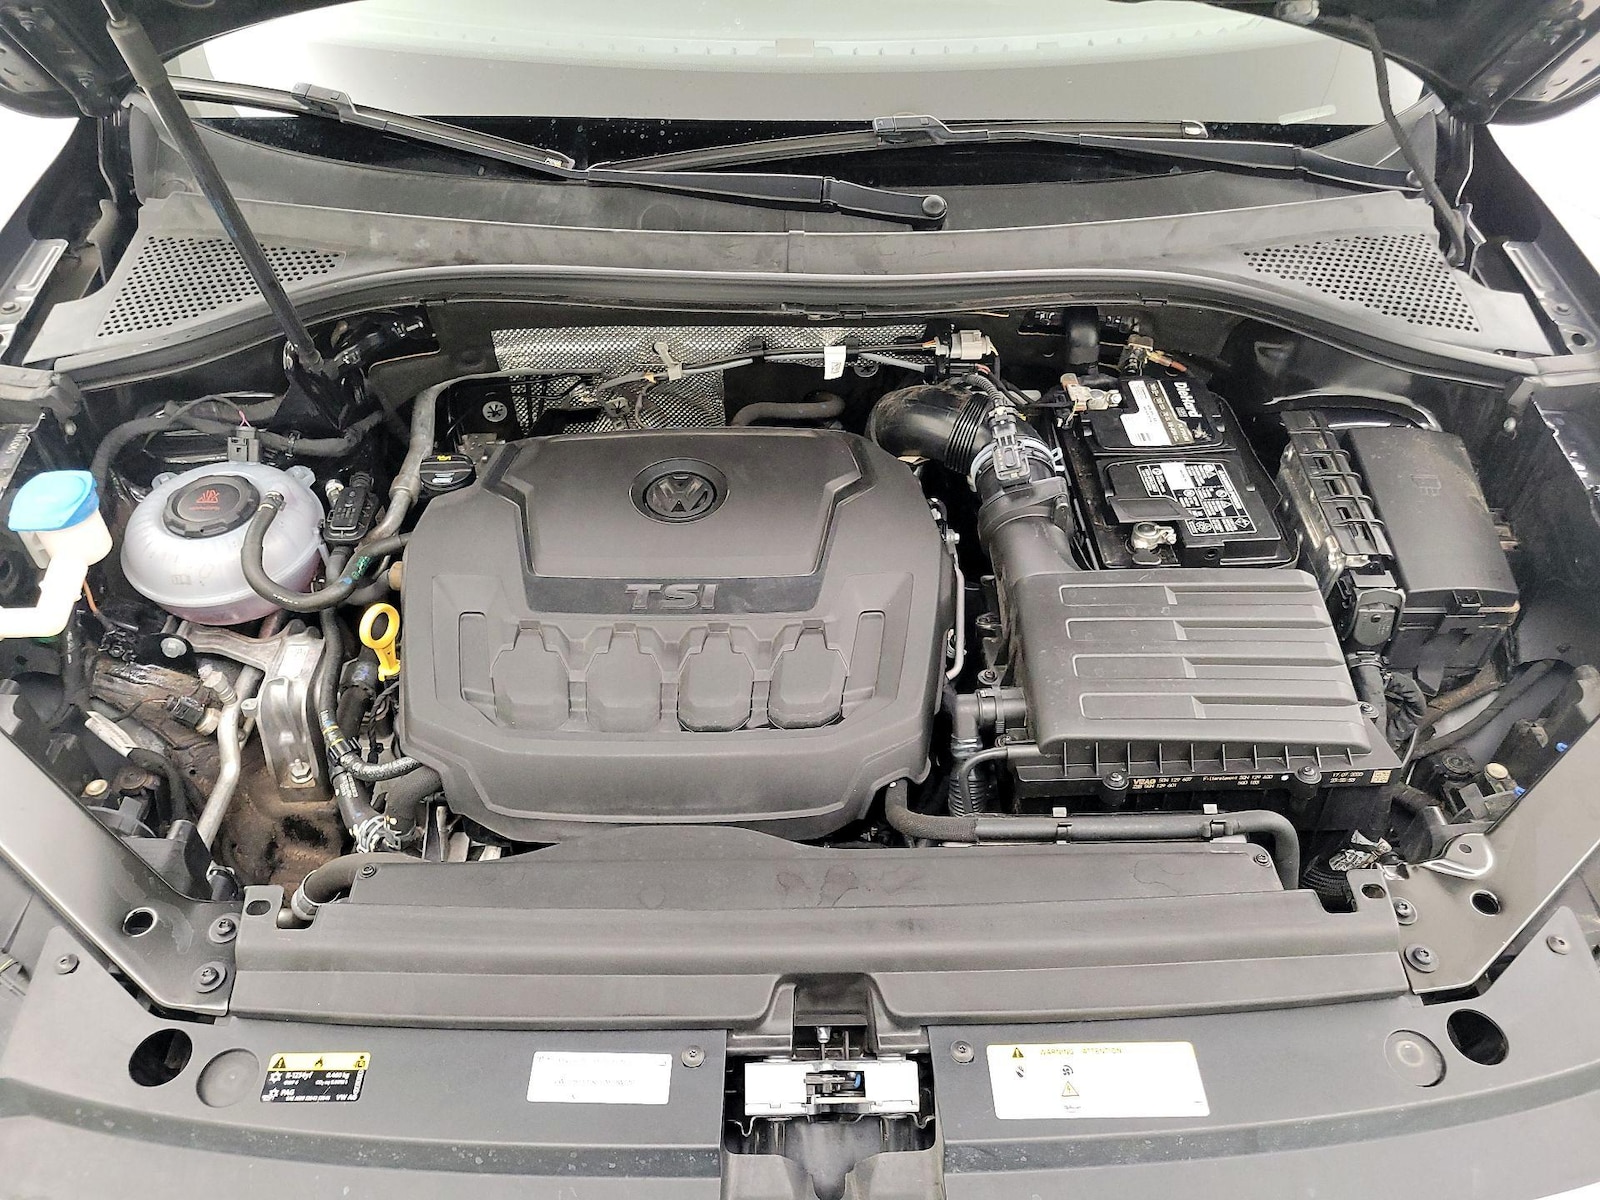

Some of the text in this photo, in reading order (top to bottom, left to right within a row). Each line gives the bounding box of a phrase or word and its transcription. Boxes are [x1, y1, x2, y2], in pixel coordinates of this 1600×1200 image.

[1175, 382, 1202, 418] DieHard
[624, 583, 719, 611] TSI
[280, 1088, 296, 1097] PAG
